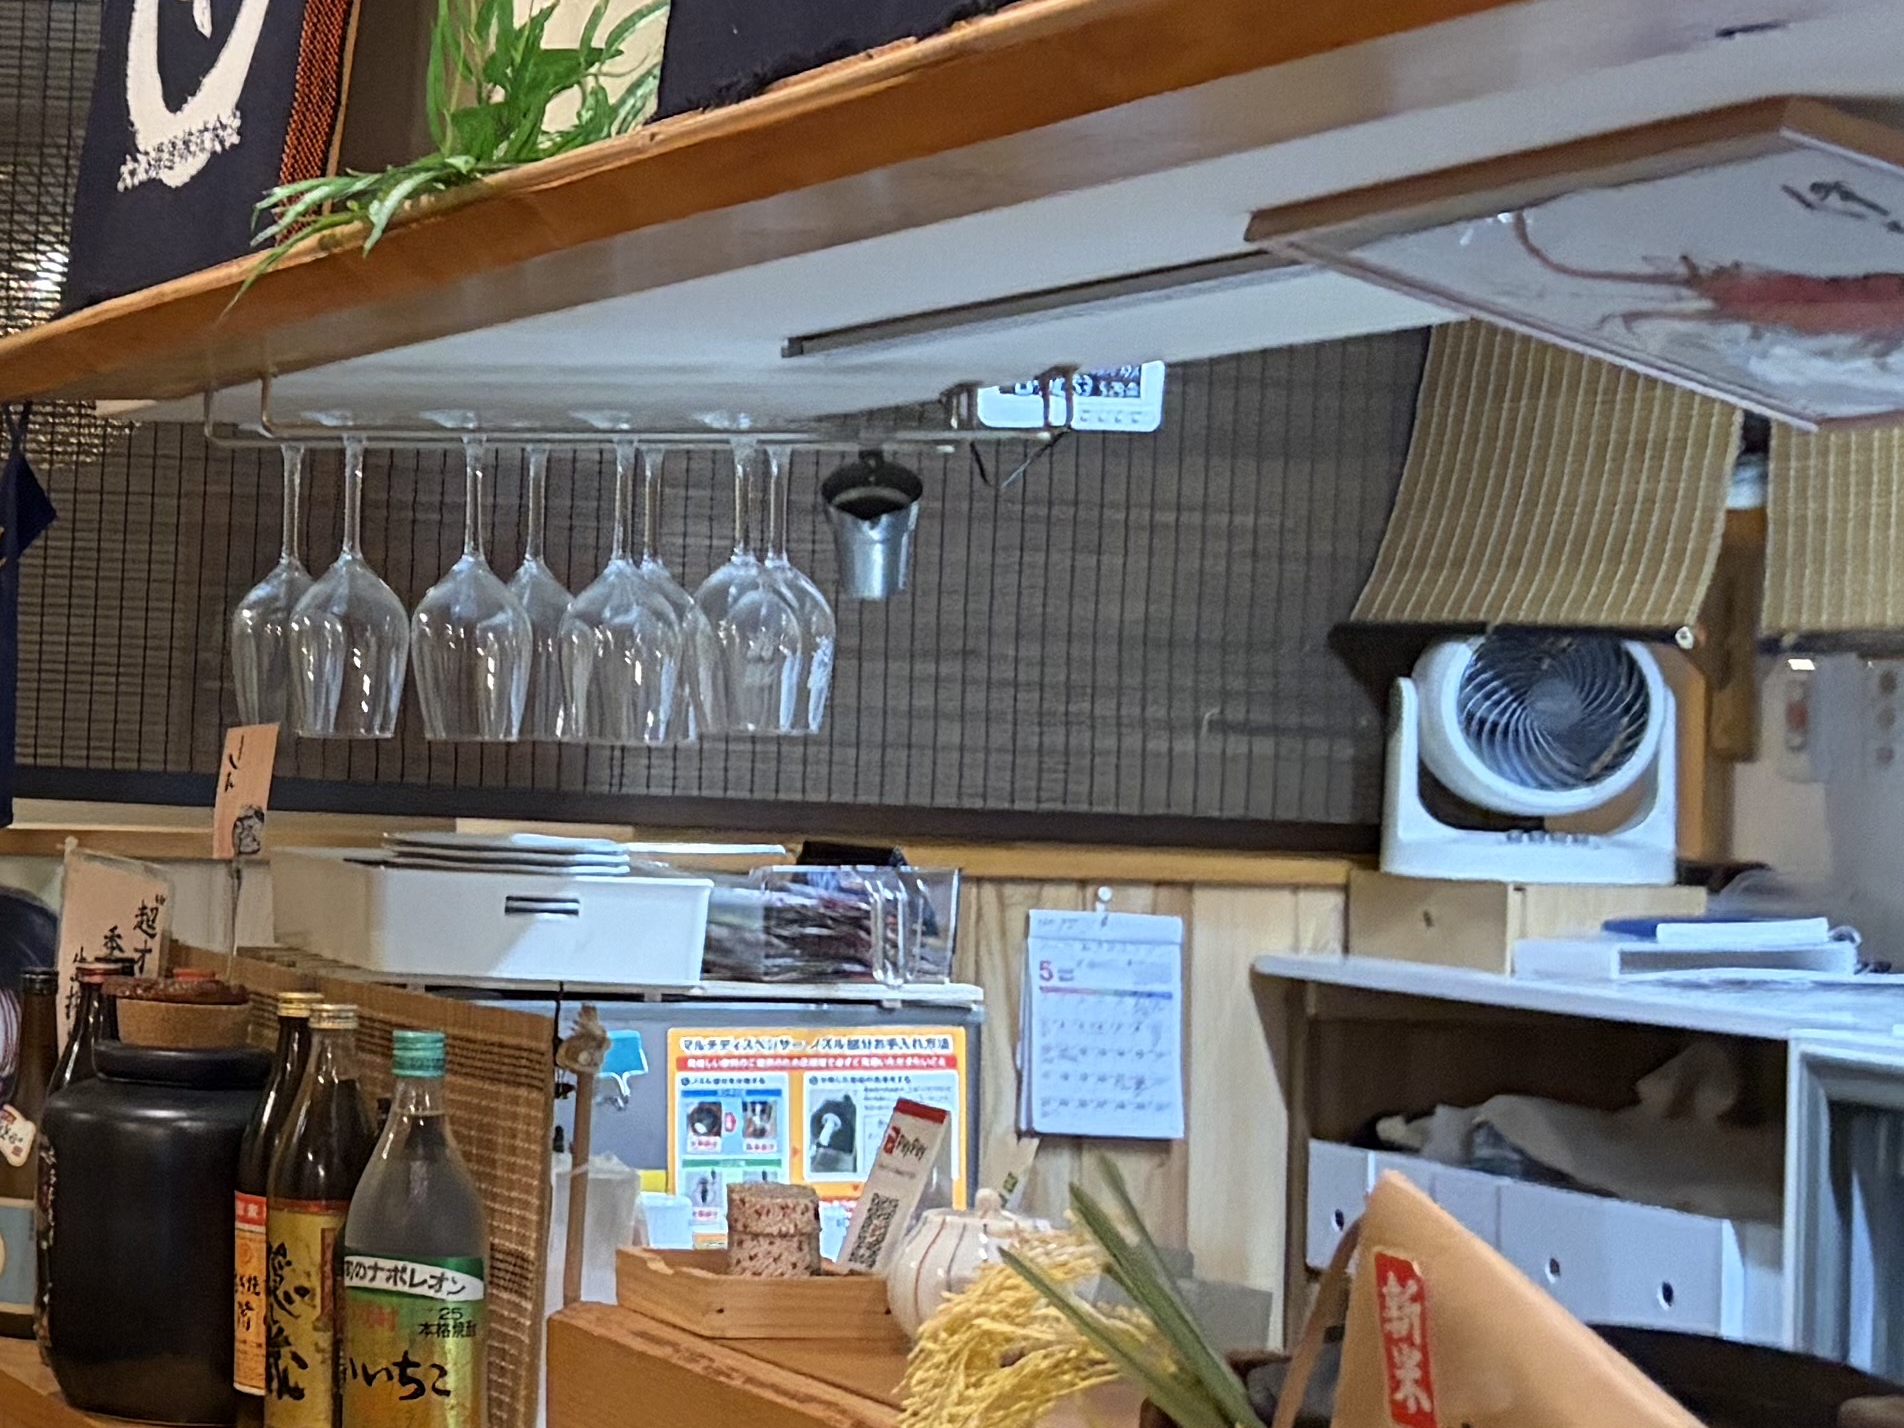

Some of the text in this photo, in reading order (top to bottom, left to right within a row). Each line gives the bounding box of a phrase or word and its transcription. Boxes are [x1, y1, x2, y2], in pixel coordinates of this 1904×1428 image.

[439, 1308, 463, 1320] 25
[418, 1322, 477, 1338] 本格焼酎
[1382, 1270, 1434, 1415] 新米
